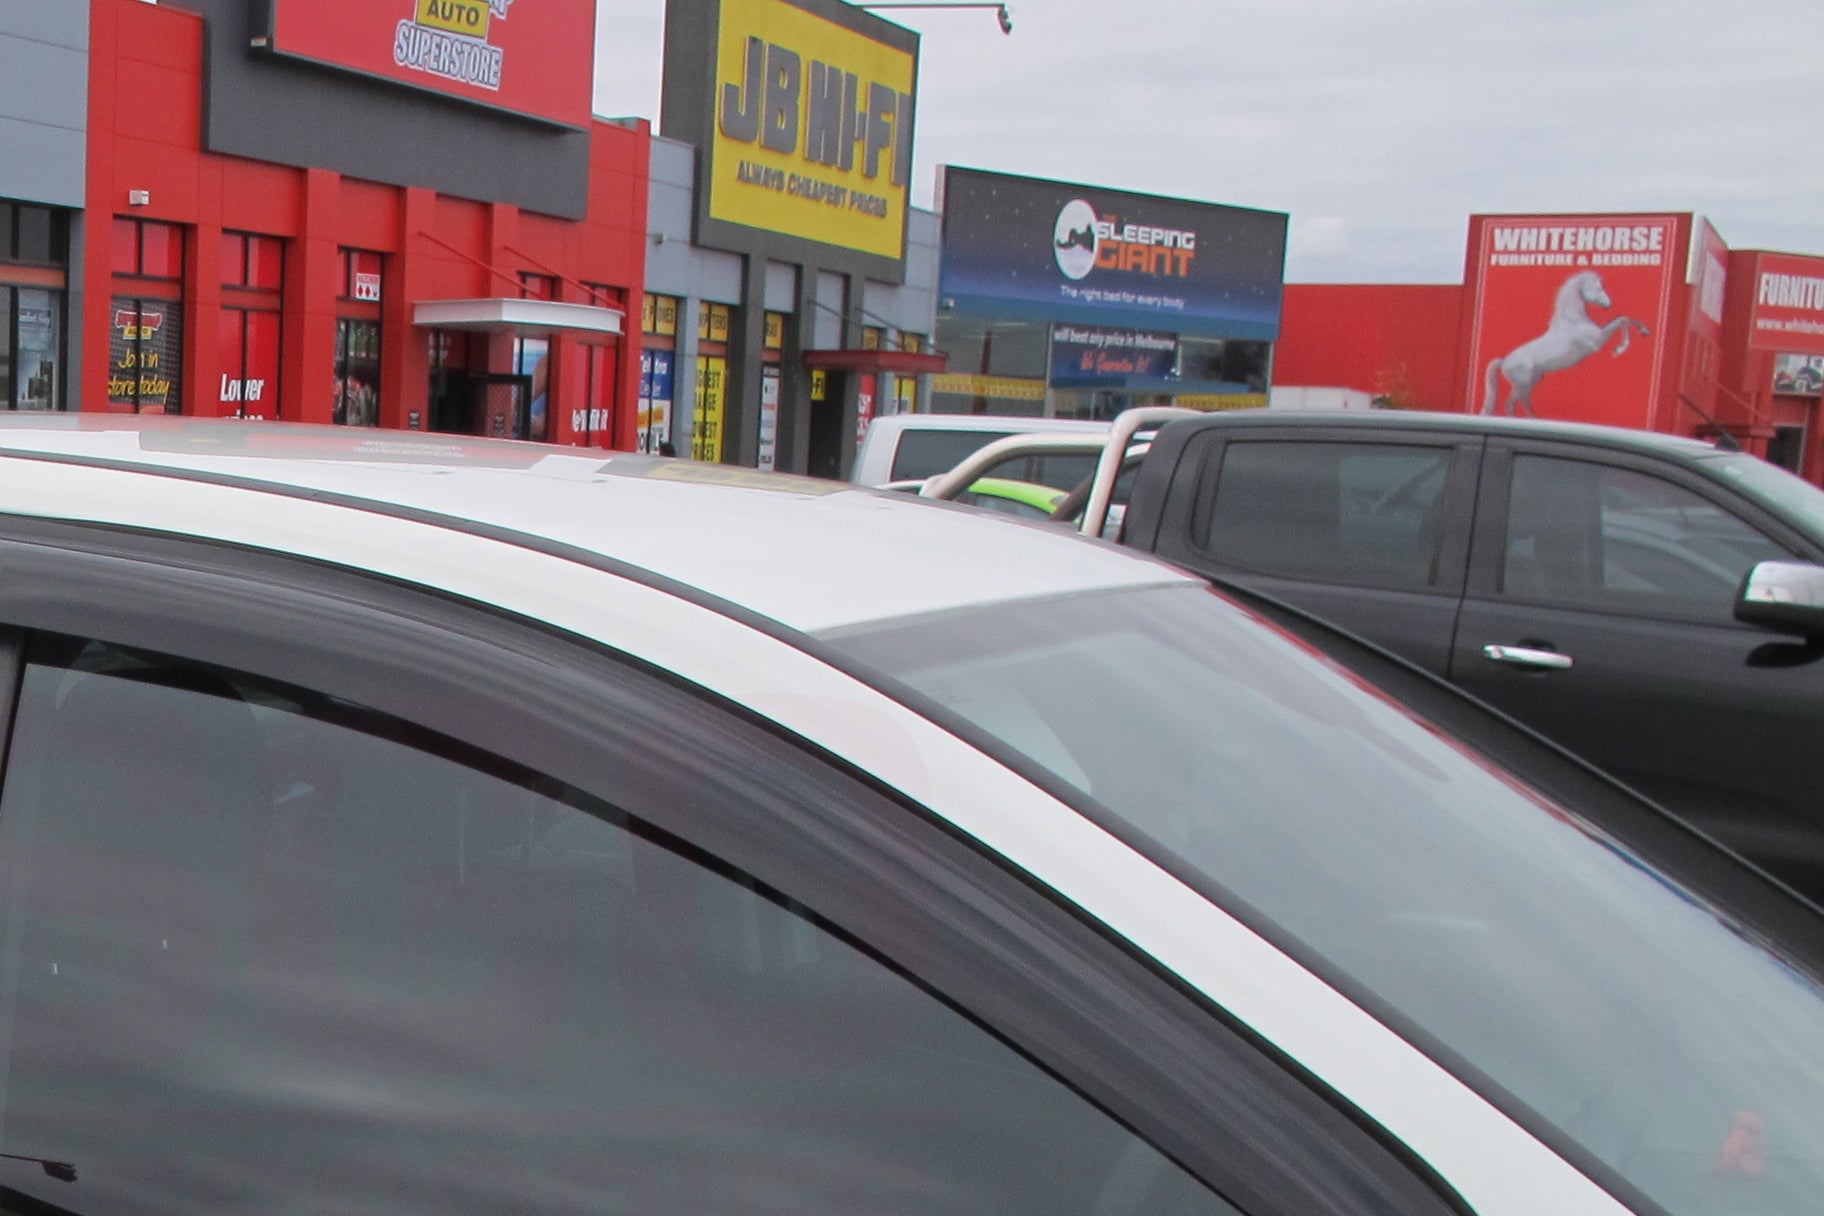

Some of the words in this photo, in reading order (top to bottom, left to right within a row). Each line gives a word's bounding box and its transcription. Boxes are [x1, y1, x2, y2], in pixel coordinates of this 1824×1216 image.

[427, 0, 480, 26] AUTO
[395, 23, 502, 88] SUPERSTORE
[719, 35, 802, 155] JB
[805, 59, 912, 187] HI-FI
[737, 160, 785, 191] ALWAYS
[787, 173, 849, 208] CHEAPEST
[849, 189, 888, 218] PRICES
[1097, 221, 1196, 249] SLEEPING
[1493, 226, 1664, 251] WHITEHORSE
[1095, 239, 1196, 277] GIANT
[1490, 253, 1575, 266] FURNITURE
[1576, 254, 1589, 266] &
[1591, 253, 1662, 266] BEDDING
